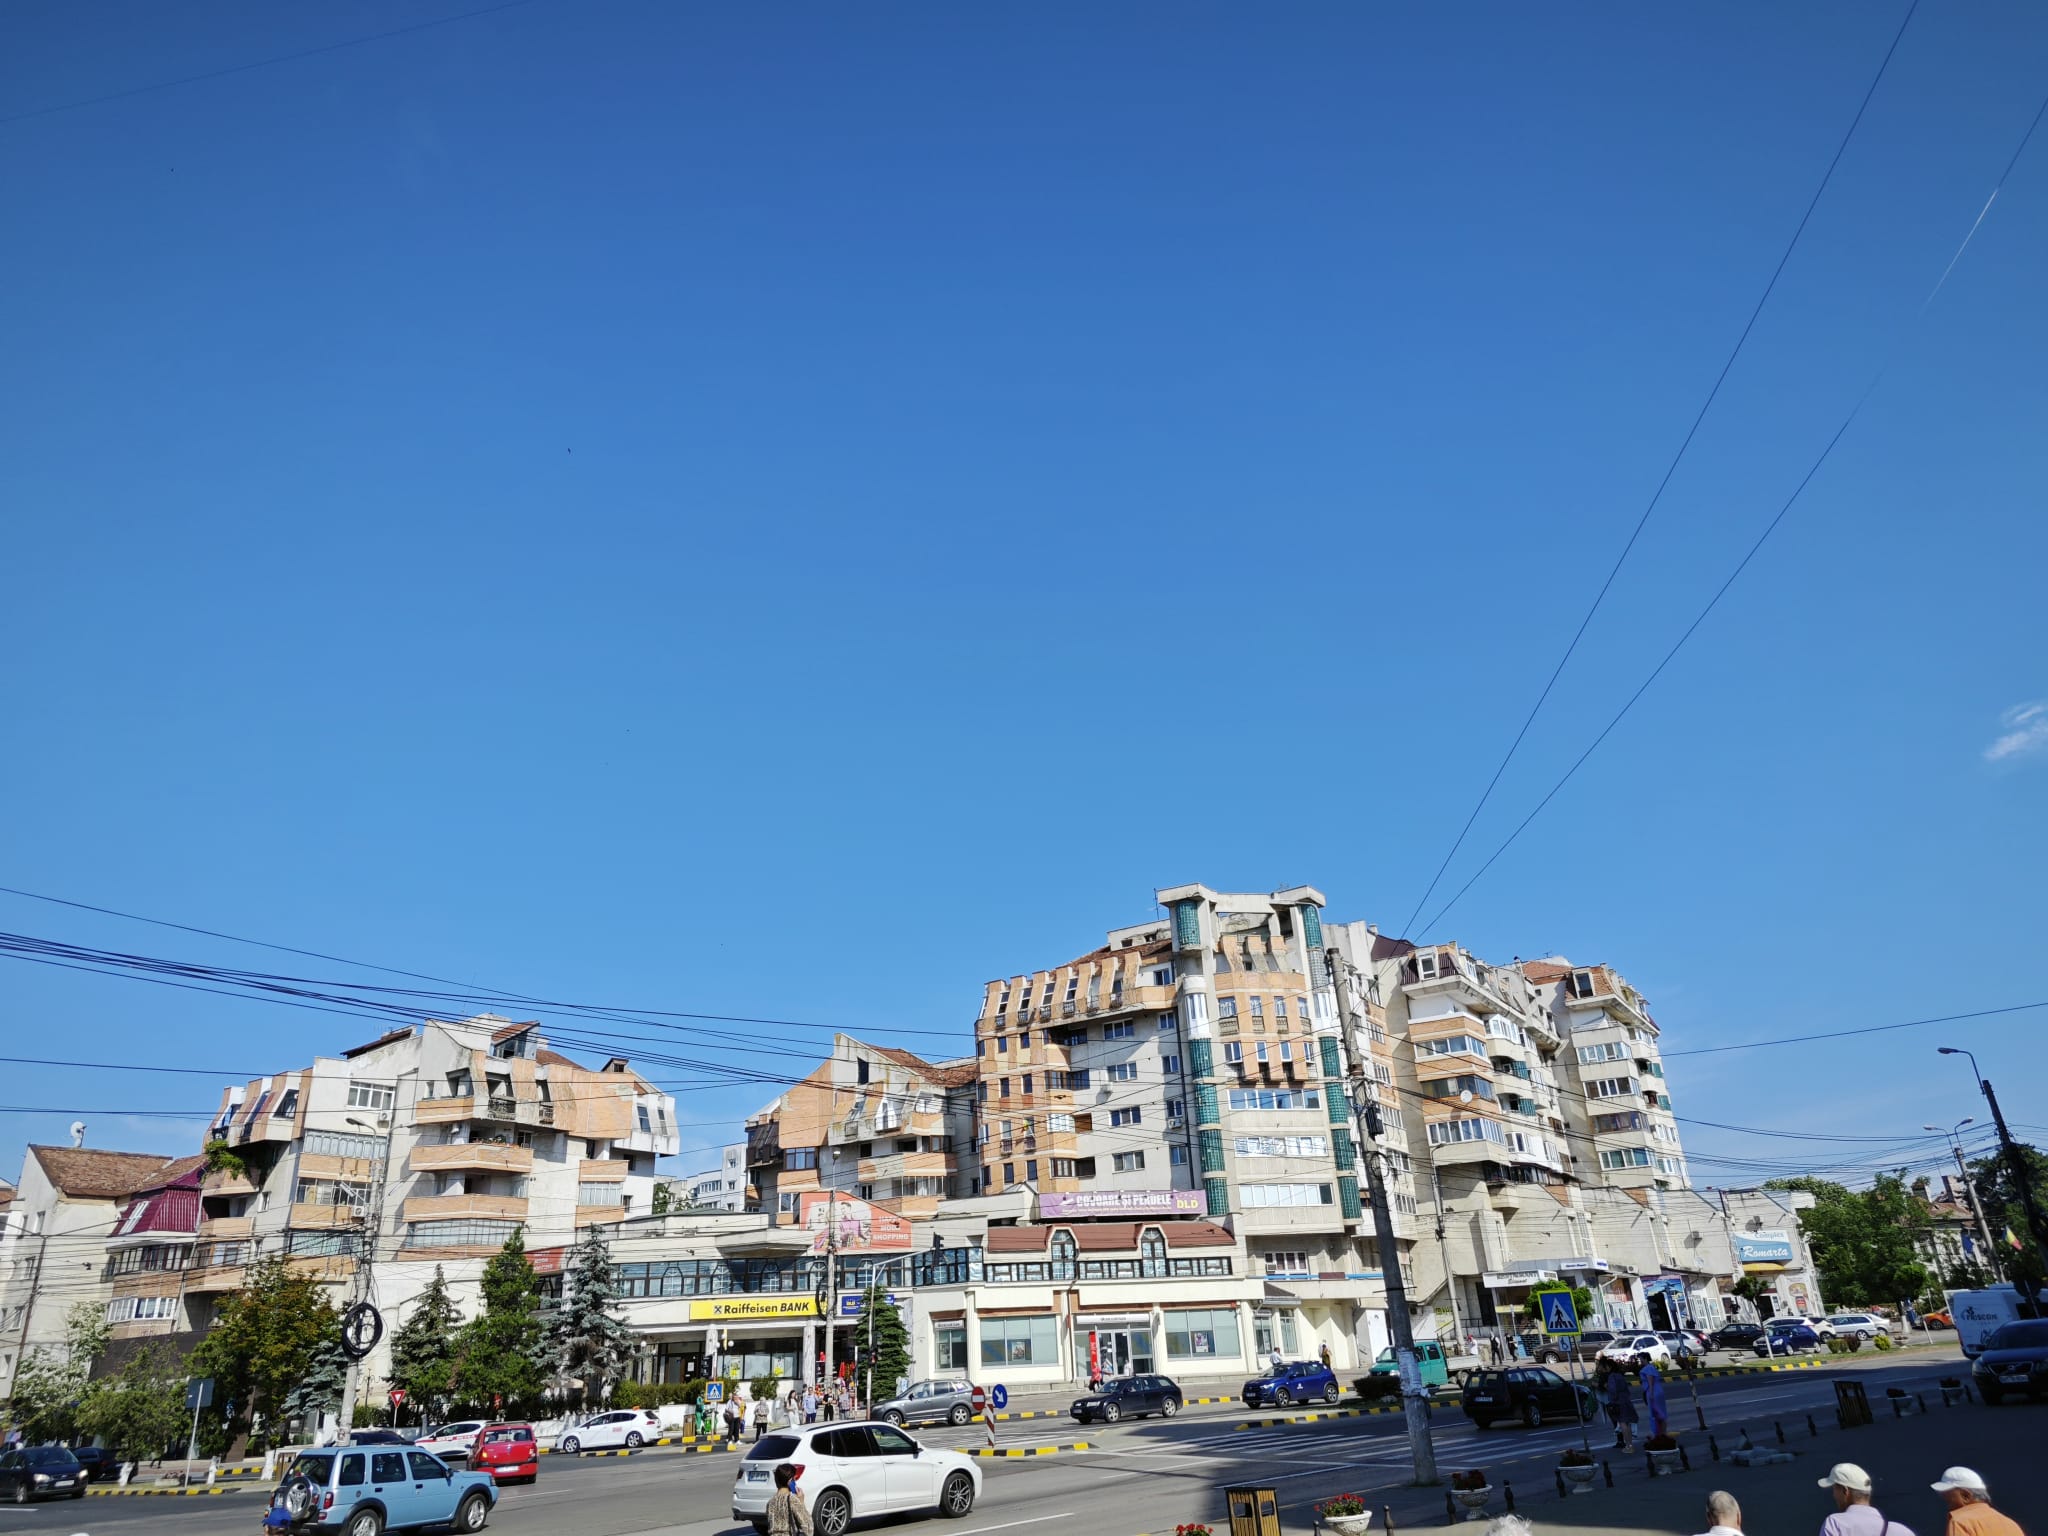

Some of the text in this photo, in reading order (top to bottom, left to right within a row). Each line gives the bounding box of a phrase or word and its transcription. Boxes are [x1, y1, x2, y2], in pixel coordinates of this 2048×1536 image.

[1176, 1199, 1198, 1209] DLD
[1743, 1245, 1789, 1258] Romarta
[724, 1302, 809, 1314] Raiffeisen BANK
